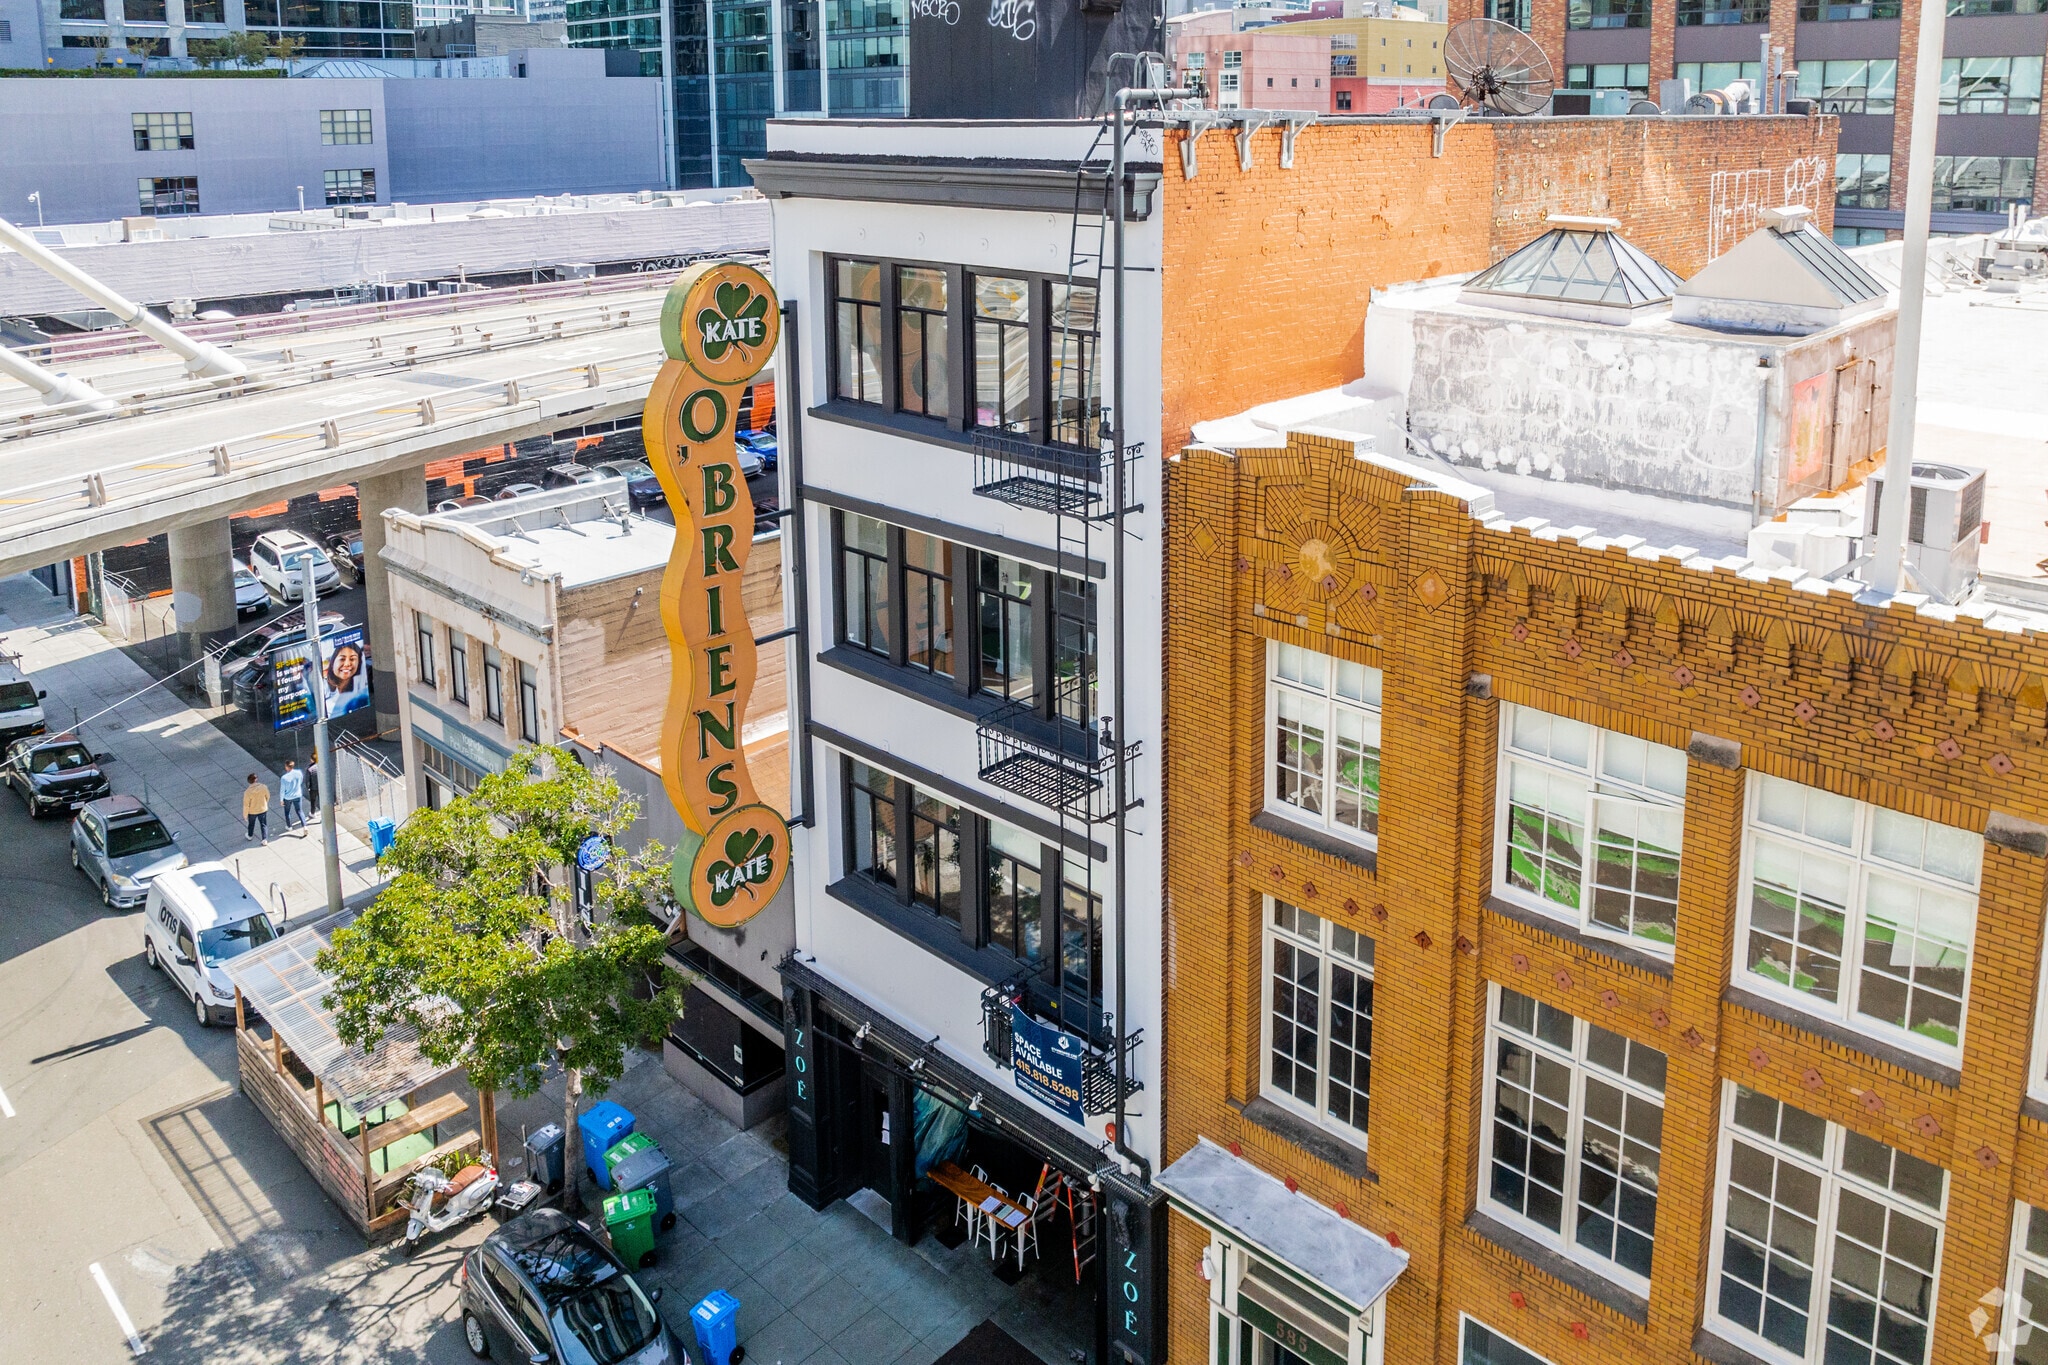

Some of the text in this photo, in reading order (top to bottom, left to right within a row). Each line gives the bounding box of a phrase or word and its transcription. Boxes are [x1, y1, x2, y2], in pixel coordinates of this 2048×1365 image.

[705, 317, 761, 344] KATE
[281, 673, 301, 684] found
[284, 665, 304, 675] where
[278, 686, 289, 694] my
[278, 689, 308, 703] purpose.
[714, 853, 769, 894] KATE
[160, 906, 178, 935] OTIS
[1014, 1032, 1042, 1060] SPACE
[1015, 1045, 1063, 1080] AVAILABLE
[1015, 1058, 1080, 1103] 415.818.5298
[1275, 1322, 1309, 1354] 585
